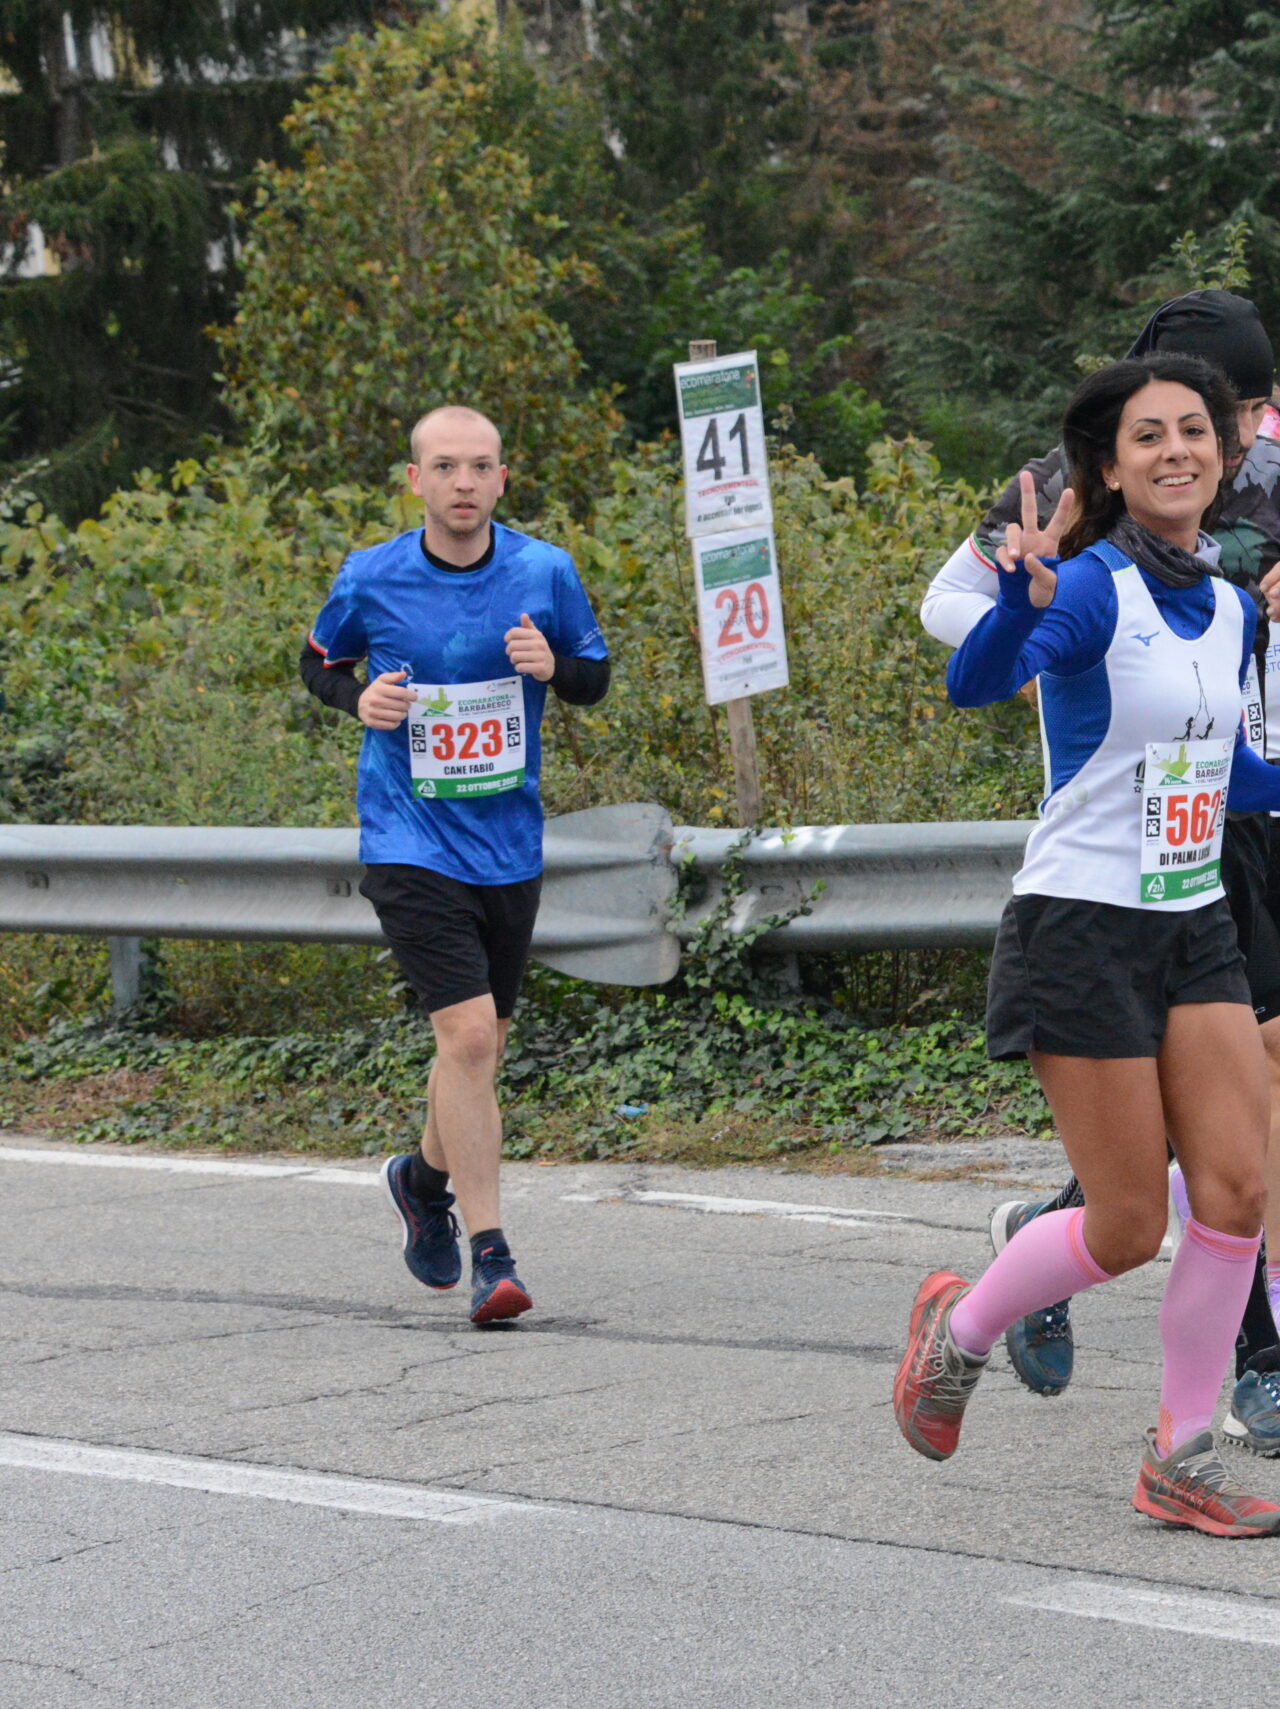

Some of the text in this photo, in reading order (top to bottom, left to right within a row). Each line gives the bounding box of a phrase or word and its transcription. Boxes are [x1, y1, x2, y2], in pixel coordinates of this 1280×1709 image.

[696, 412, 751, 480] 41
[715, 582, 769, 648] 20
[458, 694, 509, 706] ECOMARATONA
[459, 699, 512, 712] BARBARESCO
[431, 719, 503, 761] 323
[444, 762, 495, 776] CANE FABIO
[1166, 789, 1221, 847] 562
[1160, 852, 1169, 866] DI
[1171, 850, 1196, 865] PALMA
